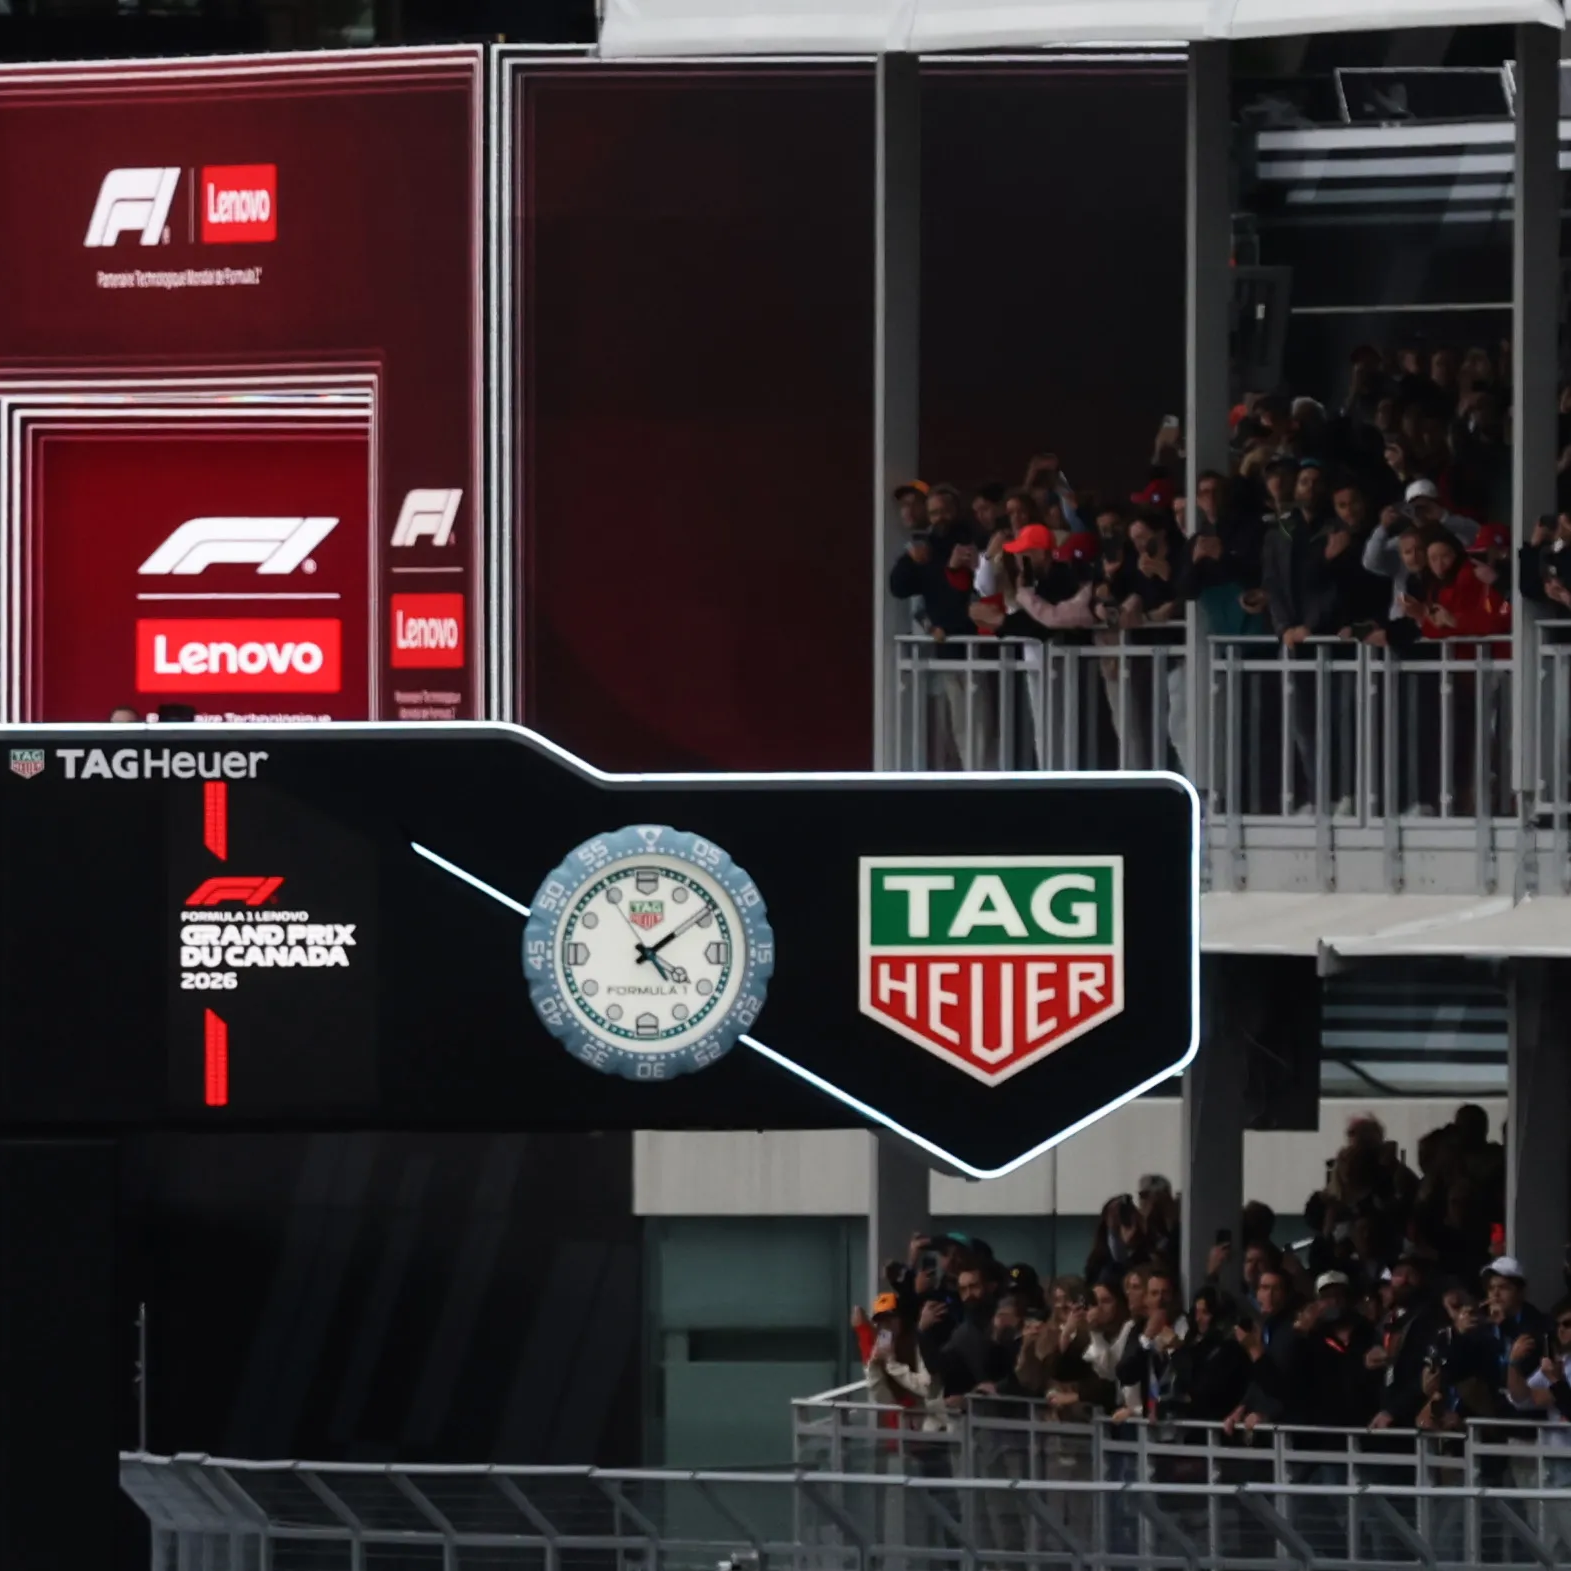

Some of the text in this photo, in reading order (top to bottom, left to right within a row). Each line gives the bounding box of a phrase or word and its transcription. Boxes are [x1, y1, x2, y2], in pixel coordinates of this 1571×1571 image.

[208, 180, 270, 224] Lenovo
[396, 609, 458, 648] Lenovo
[153, 634, 325, 675] Lenovo
[579, 838, 609, 864] 55
[180, 910, 245, 922] FORMULA
[254, 910, 310, 922] LENOVO
[634, 901, 662, 913] TAG
[883, 874, 1098, 939] TAG
[180, 925, 357, 947] GRAND PRIX
[180, 946, 350, 968] DU CANADA
[527, 940, 545, 971] 45
[756, 940, 772, 966] 15
[180, 972, 238, 990] 2026
[606, 984, 678, 995] FORMULA
[879, 961, 1105, 1065] HEUER
